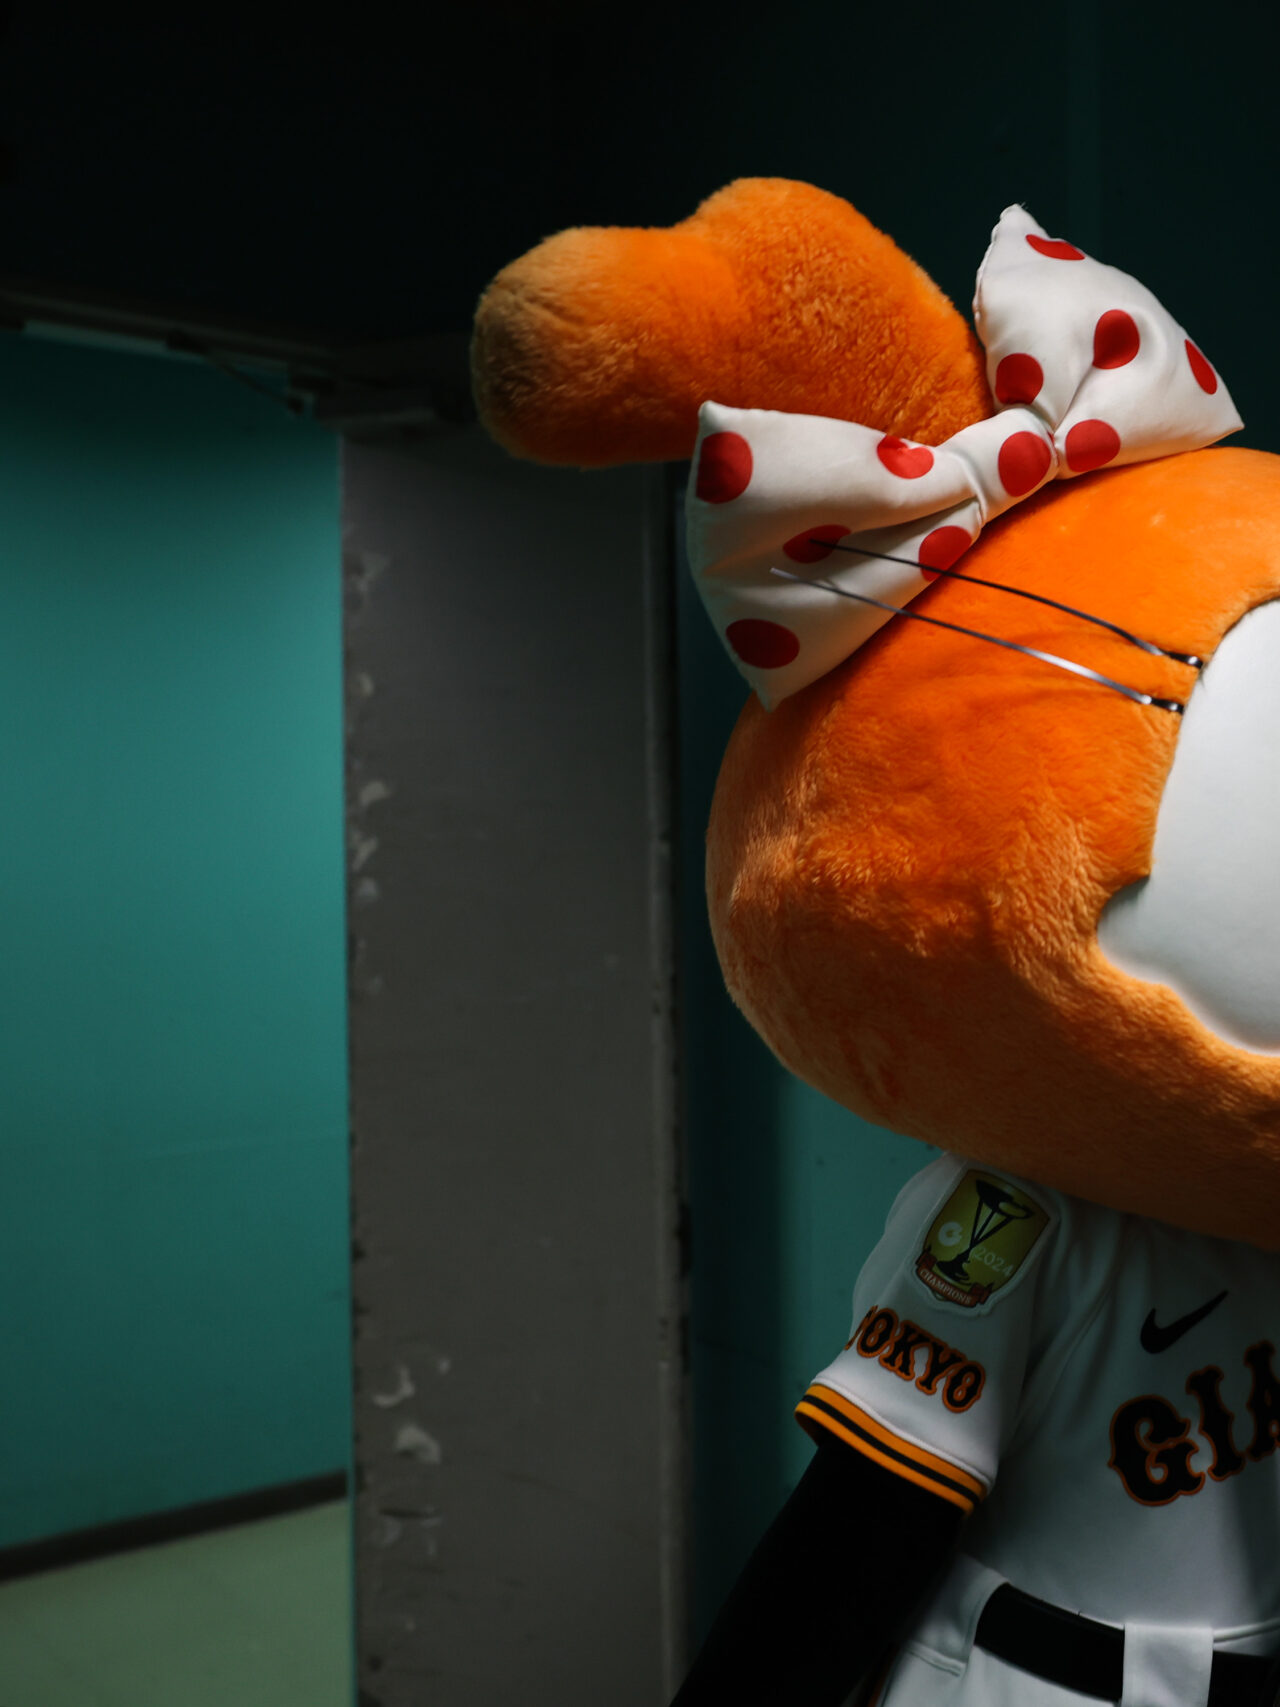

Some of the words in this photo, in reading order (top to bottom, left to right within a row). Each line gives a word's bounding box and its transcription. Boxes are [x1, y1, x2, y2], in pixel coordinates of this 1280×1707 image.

[973, 1247, 1014, 1277] 2024
[919, 1268, 973, 1305] CHAMPIONS
[845, 1305, 986, 1413] OKYO
